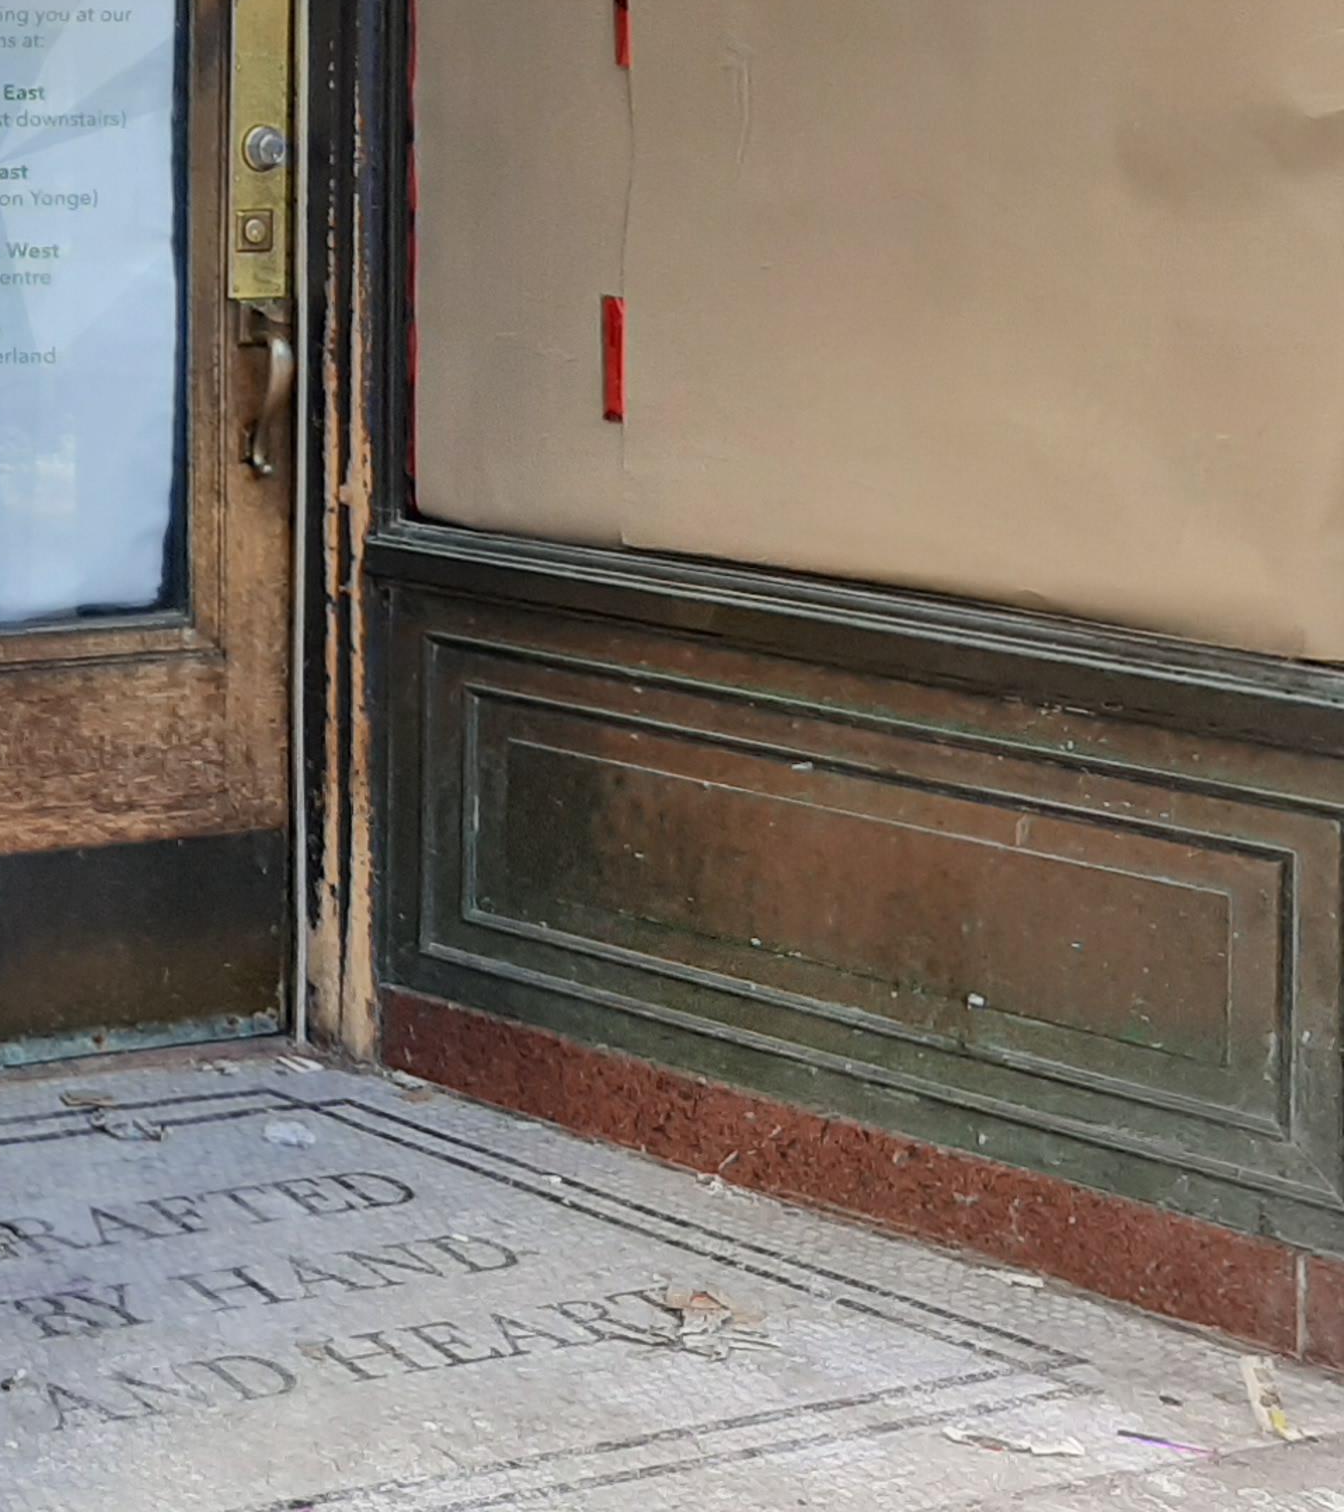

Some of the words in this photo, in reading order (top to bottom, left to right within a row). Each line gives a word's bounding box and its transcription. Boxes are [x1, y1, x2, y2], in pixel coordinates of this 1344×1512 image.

[35, 10, 70, 26] you
[76, 8, 95, 22] at
[100, 10, 132, 22] our
[22, 35, 44, 48] at:
[4, 85, 45, 100] East
[16, 110, 126, 128] downstairs)
[29, 190, 98, 210] Yonge)
[6, 244, 59, 258] West
[2, 1283, 154, 1340] BY
[170, 1233, 520, 1312] HAND
[44, 1354, 299, 1431] AND
[305, 1286, 686, 1383] HEART
